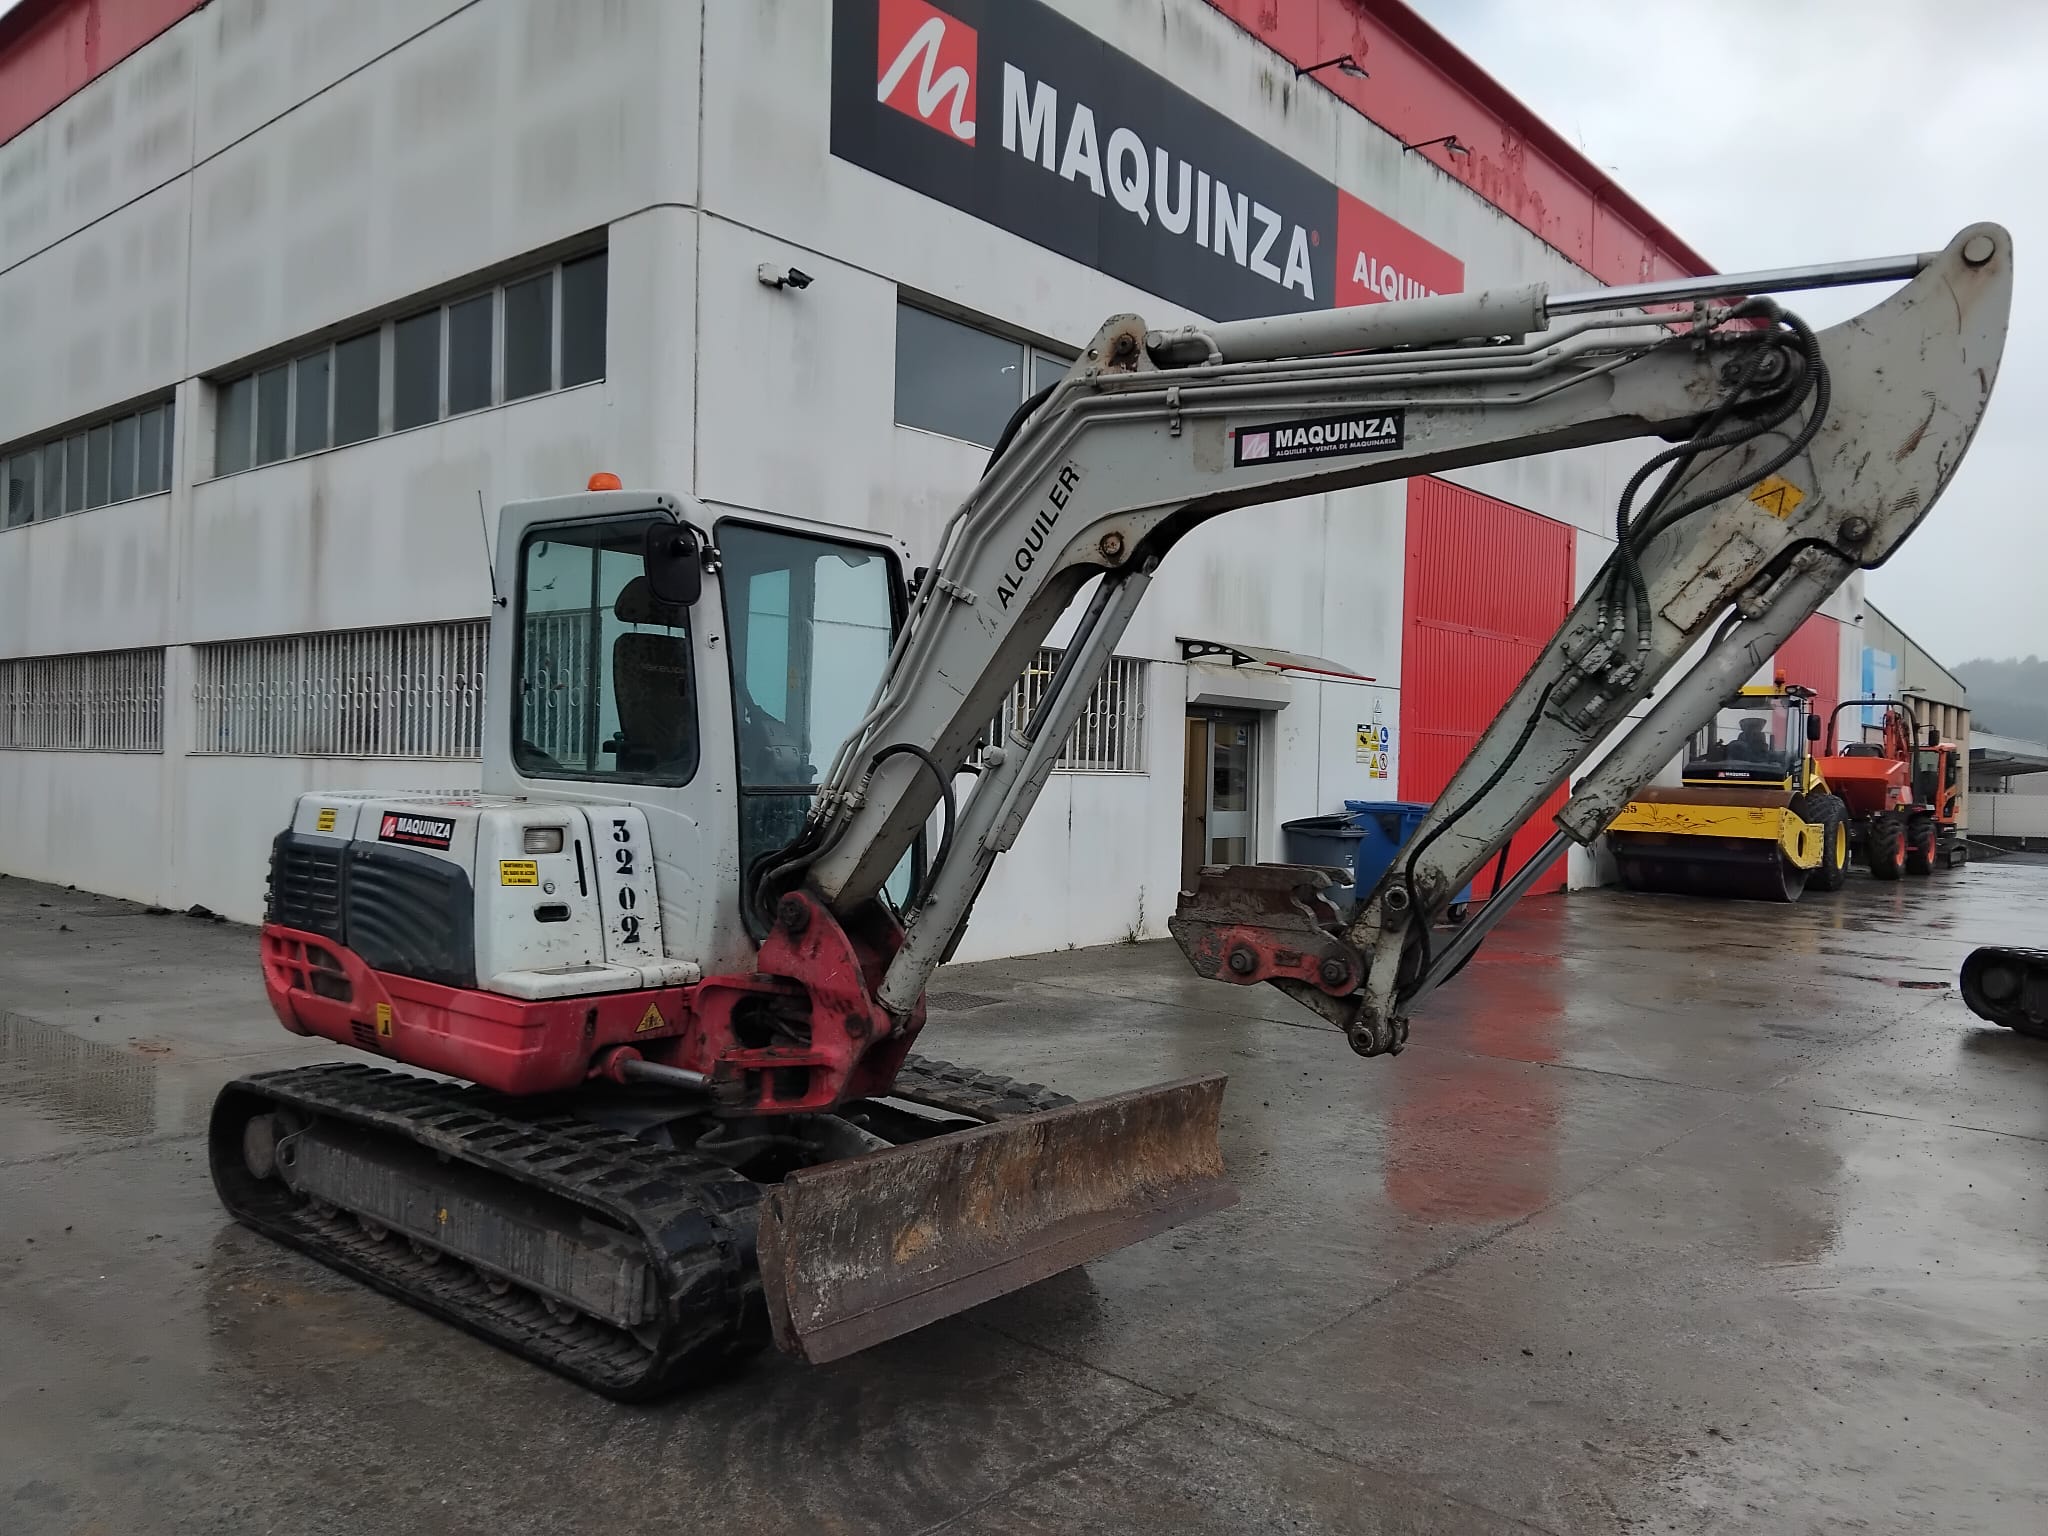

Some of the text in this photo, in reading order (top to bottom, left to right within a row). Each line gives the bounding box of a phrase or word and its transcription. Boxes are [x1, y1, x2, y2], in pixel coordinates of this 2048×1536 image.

[1002, 61, 1314, 301] MAQUINZA
[1352, 251, 1439, 301] ALQUIL
[1275, 416, 1397, 448] MAQUINZA
[1276, 447, 1307, 457] ALQUILER
[1315, 444, 1337, 452] VENTA
[1350, 438, 1396, 449] MAQUINARIA
[997, 466, 1080, 611] ALQUILER
[396, 817, 451, 839] MAQUINZA
[612, 820, 640, 944] 3202
